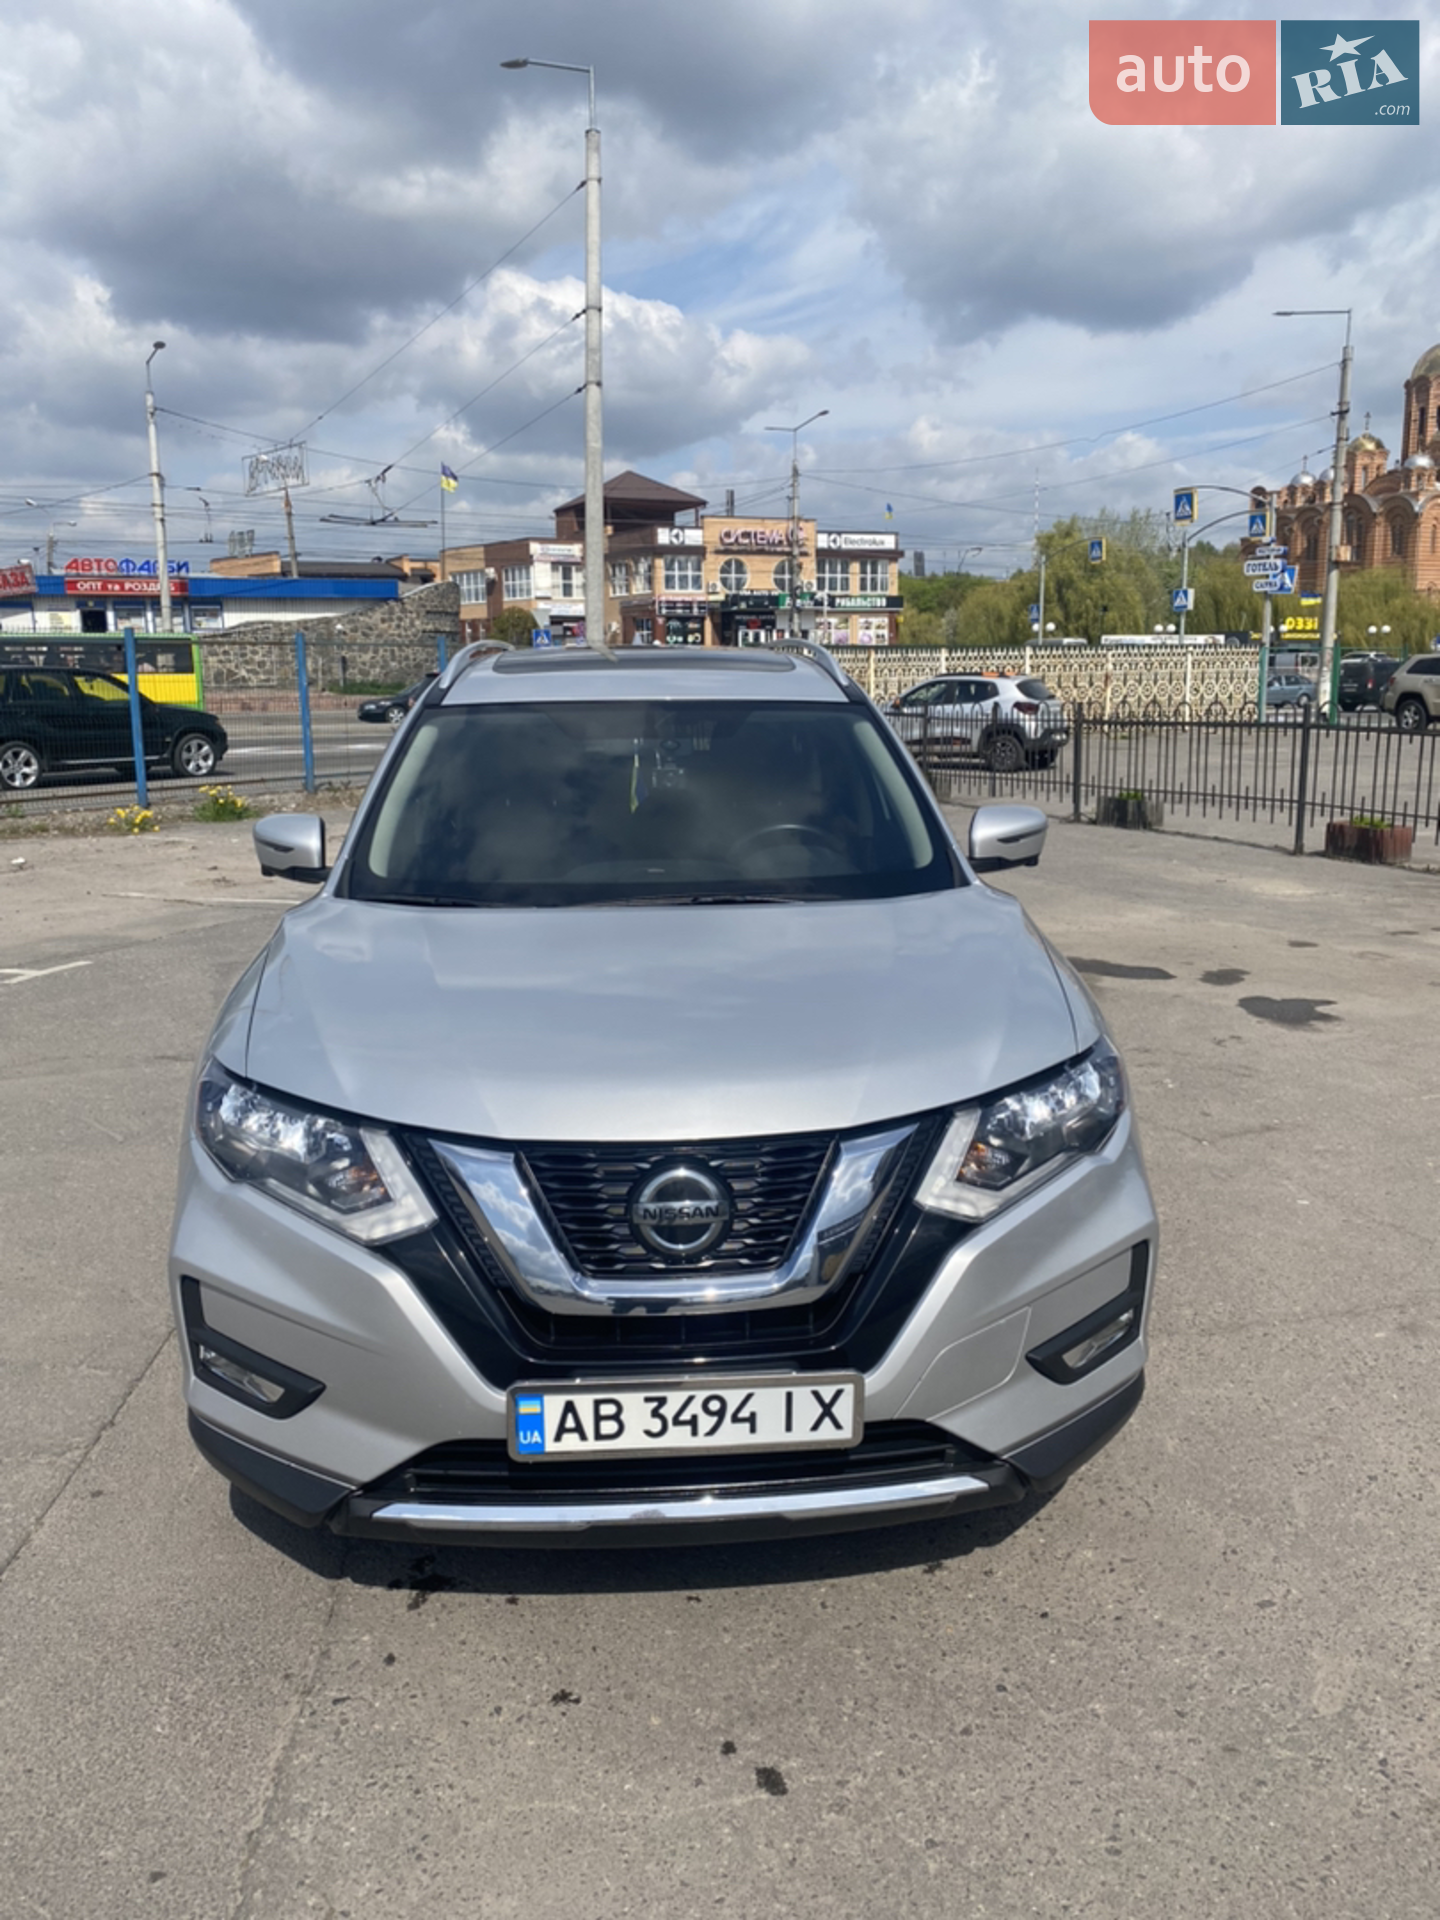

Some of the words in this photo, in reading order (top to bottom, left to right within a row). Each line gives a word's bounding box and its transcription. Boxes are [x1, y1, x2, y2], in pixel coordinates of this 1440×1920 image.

[843, 534, 885, 547] Electrolux
[76, 581, 103, 591] ОПТ
[642, 1205, 719, 1221] NISSAN
[553, 1398, 625, 1443] AB
[643, 1392, 757, 1439] 3494
[784, 1388, 845, 1433] IX
[519, 1431, 543, 1445] UA
